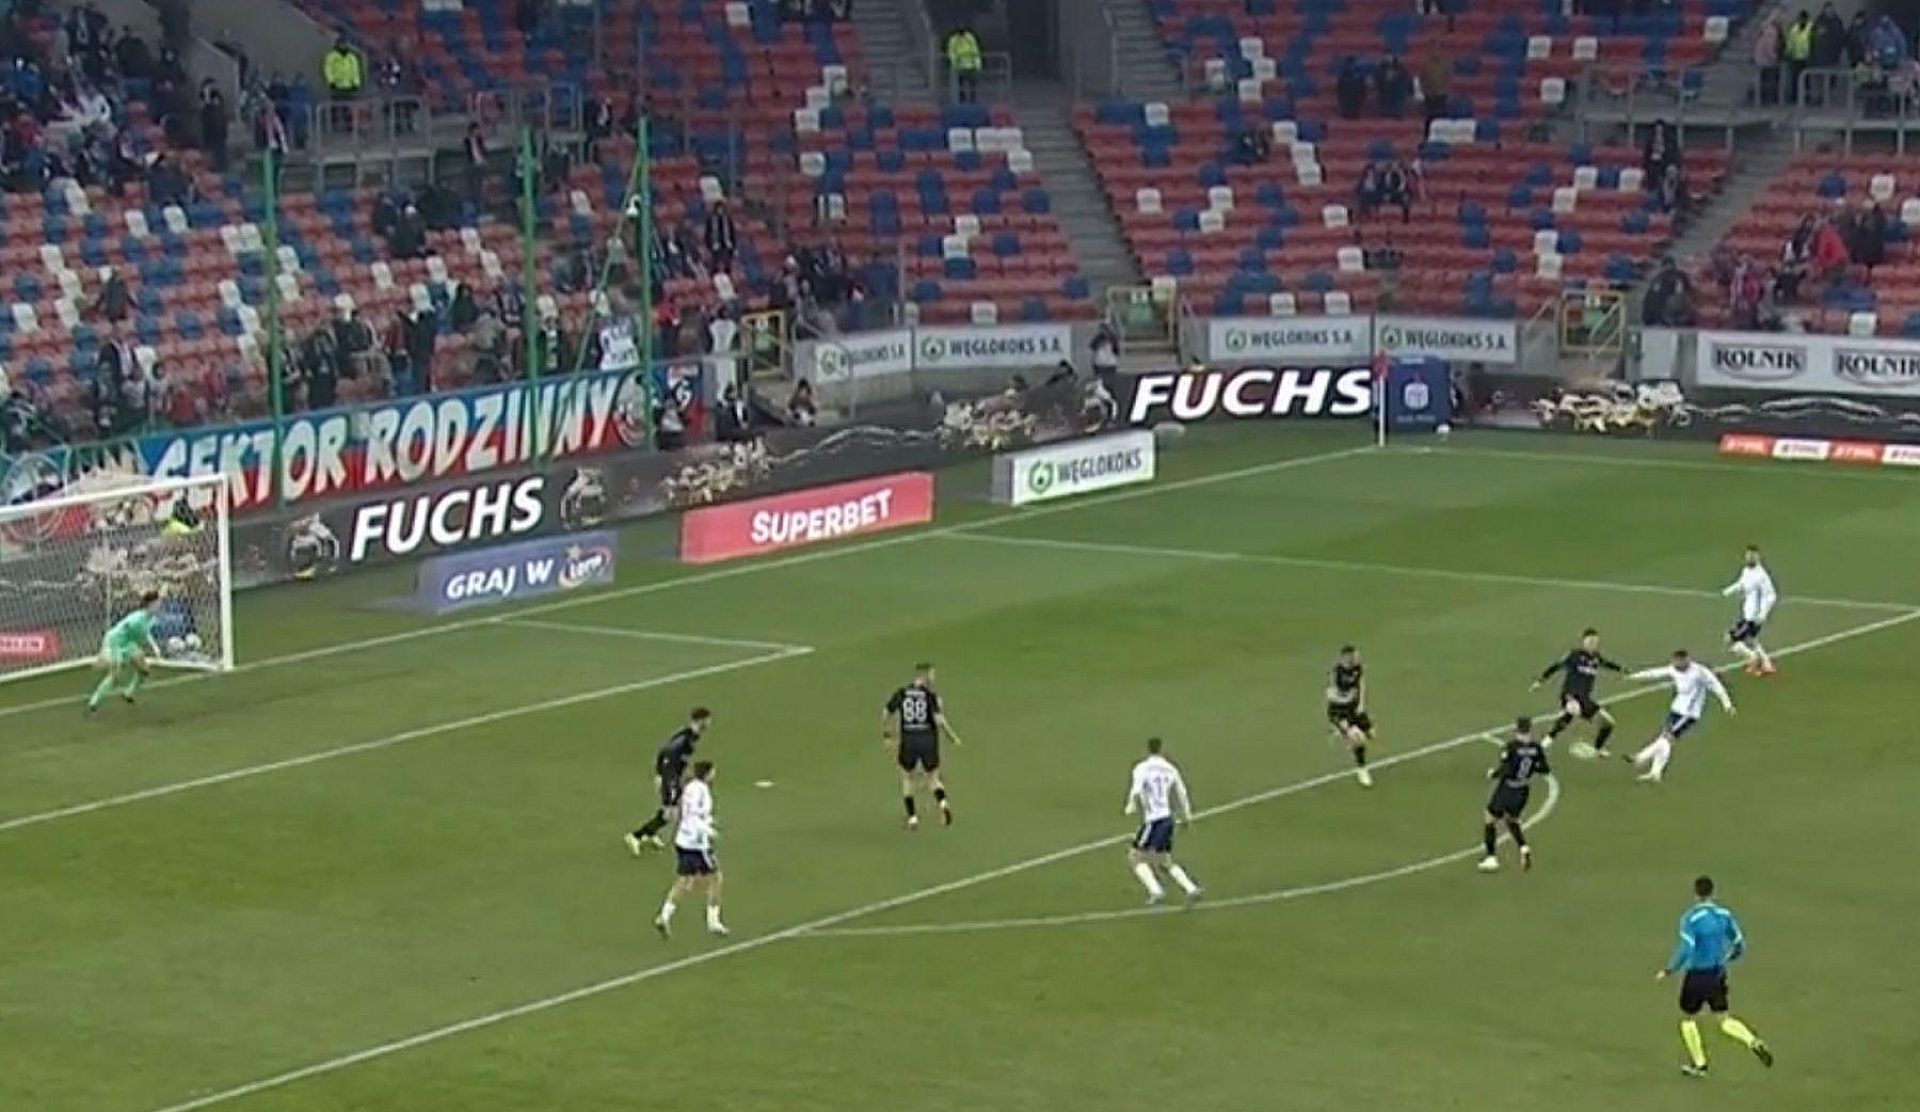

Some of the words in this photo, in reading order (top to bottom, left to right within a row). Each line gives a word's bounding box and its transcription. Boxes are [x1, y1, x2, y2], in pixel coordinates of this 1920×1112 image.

[1716, 349, 1800, 371] ROLNIK
[1130, 367, 1371, 423] FUCHS
[362, 375, 619, 484] RODZINNY
[351, 476, 544, 561] FUCHS
[751, 488, 892, 543] SUPERBET
[445, 565, 515, 599] GRAJ
[526, 559, 554, 584] W
[903, 697, 927, 722] 88
